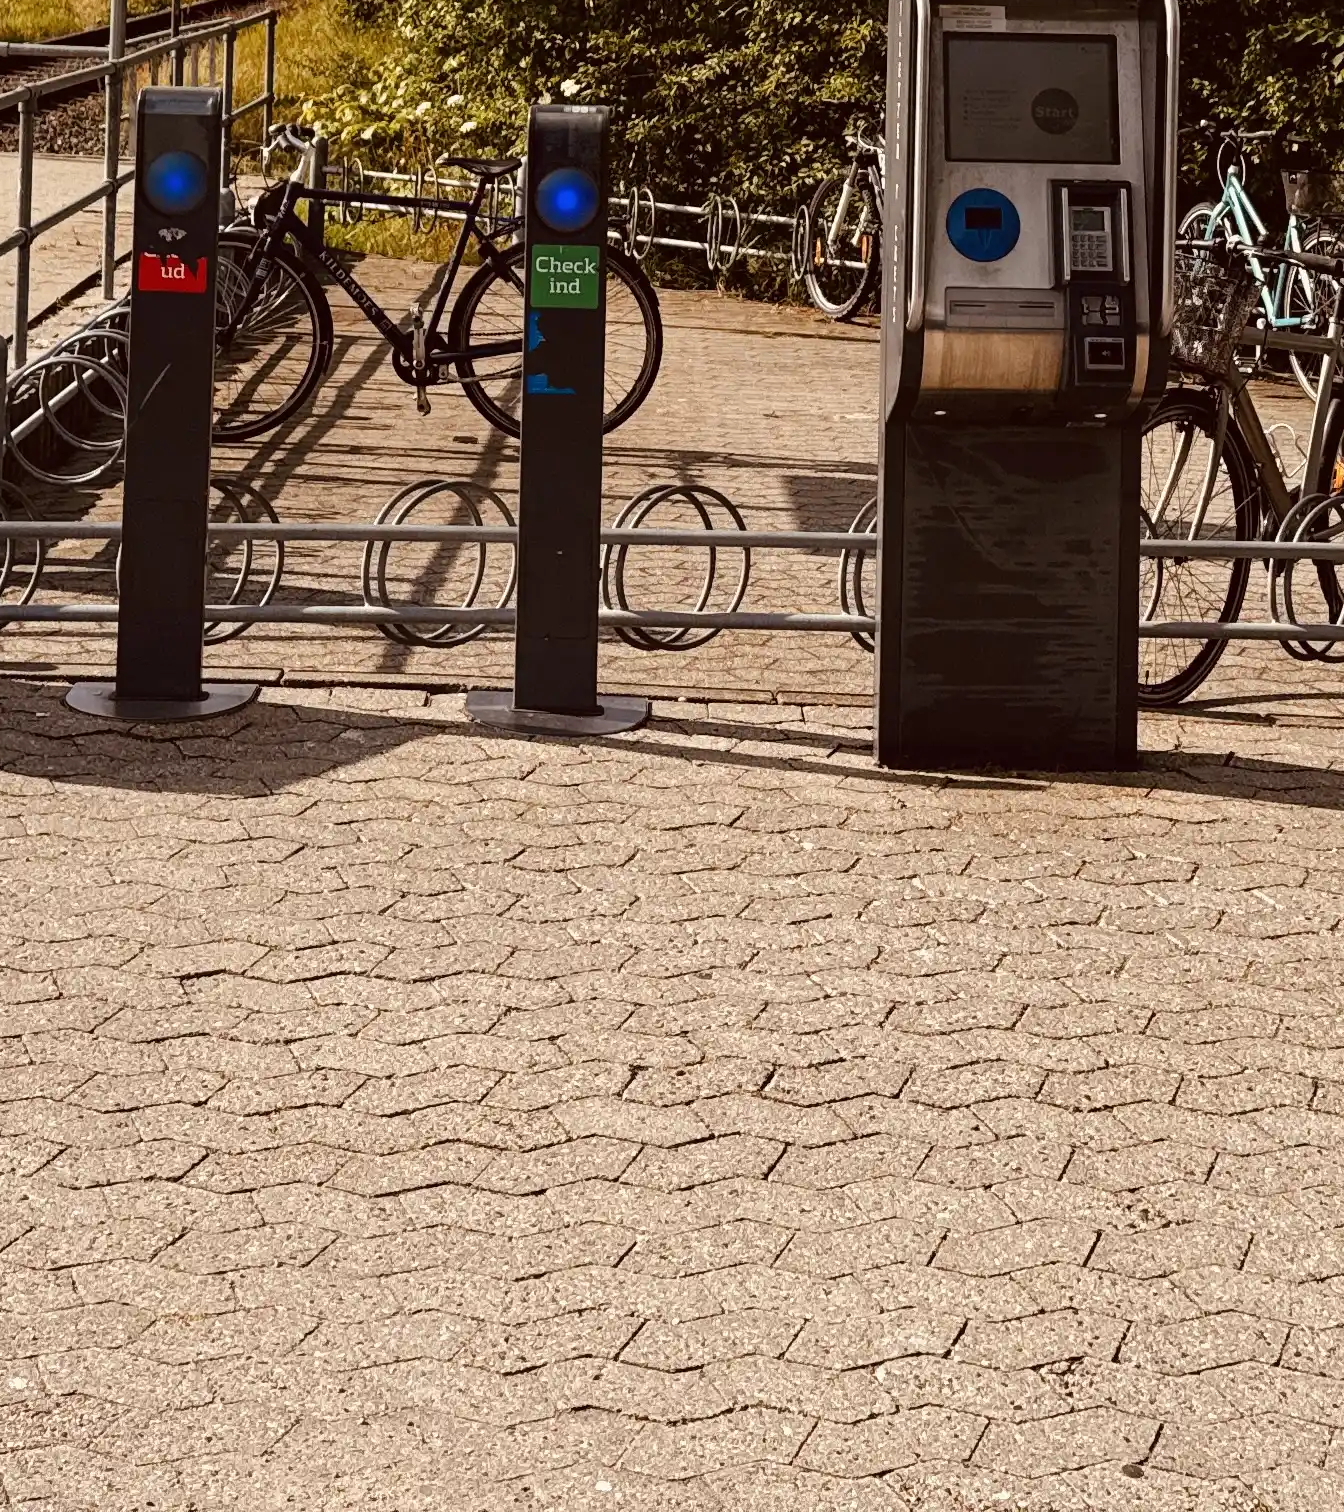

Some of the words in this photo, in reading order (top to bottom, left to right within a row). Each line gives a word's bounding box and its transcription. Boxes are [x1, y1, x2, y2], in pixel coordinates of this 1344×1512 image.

[1034, 106, 1074, 119] Start
[160, 262, 186, 279] ud
[535, 256, 597, 275] Check
[318, 250, 379, 317] KILDEMOES
[549, 277, 581, 294] ind
